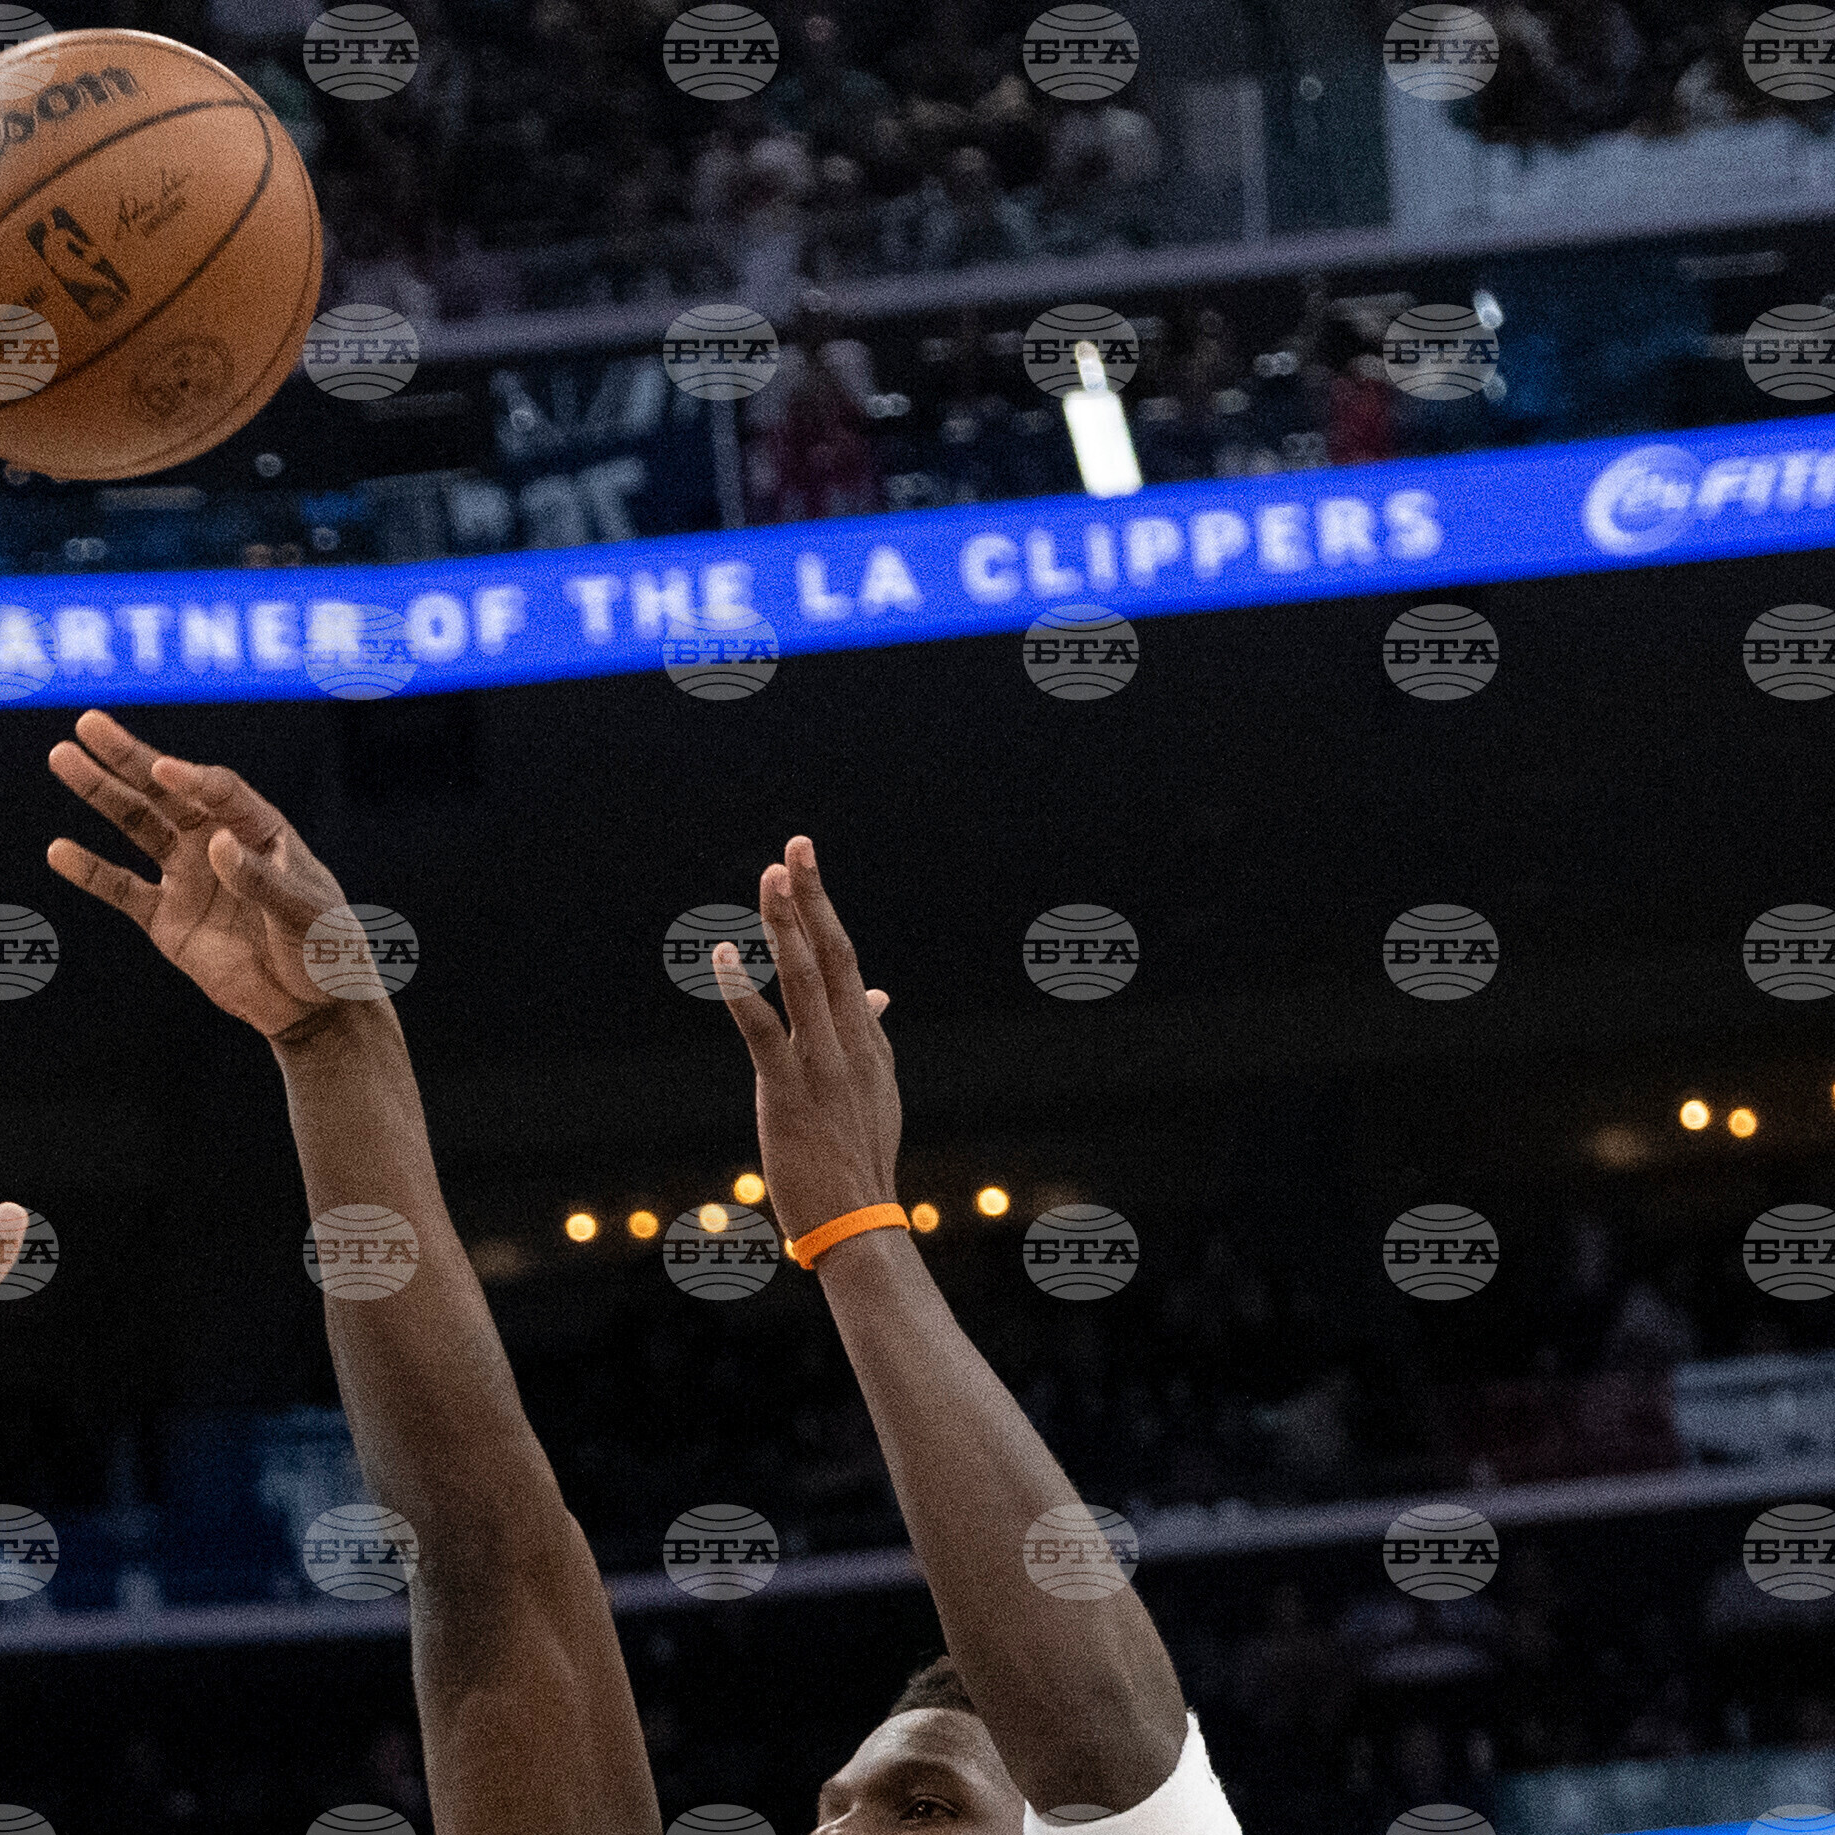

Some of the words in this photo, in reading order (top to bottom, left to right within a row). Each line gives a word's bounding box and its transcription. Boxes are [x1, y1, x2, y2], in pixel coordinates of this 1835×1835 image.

[403, 583, 526, 664] OF
[568, 560, 758, 647] THE
[794, 547, 926, 622] LA
[958, 487, 1442, 604] CLIPPERS
